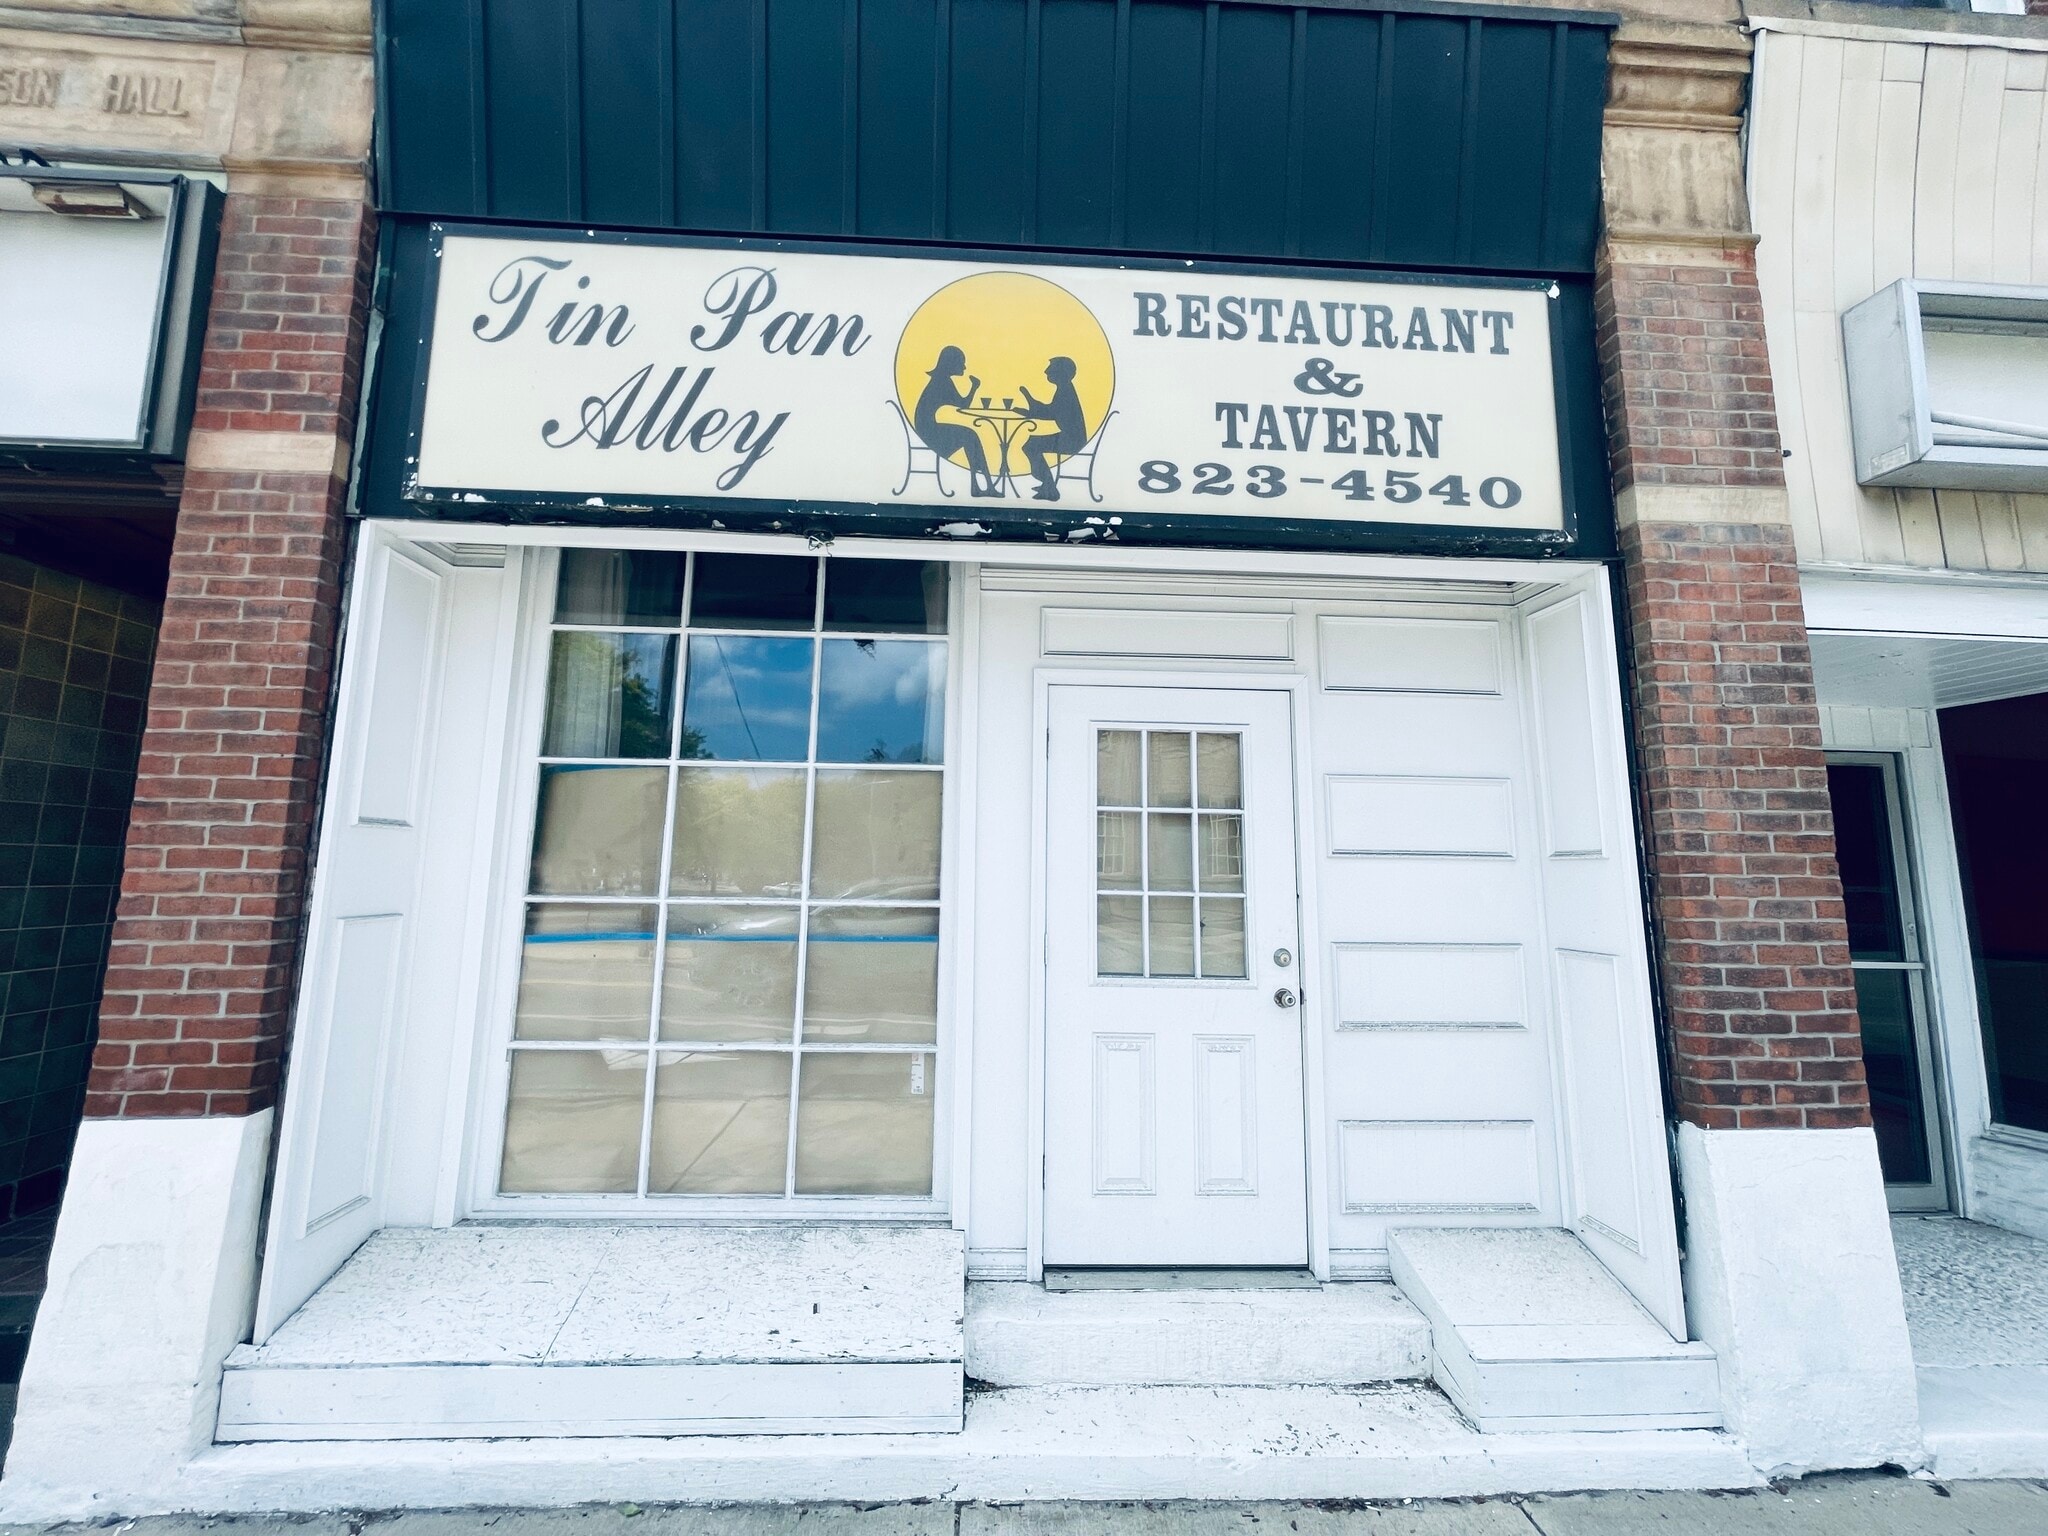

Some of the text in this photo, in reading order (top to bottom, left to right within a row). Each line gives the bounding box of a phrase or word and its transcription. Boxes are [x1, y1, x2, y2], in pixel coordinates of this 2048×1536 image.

[103, 74, 189, 118] HALL
[473, 256, 872, 357] Tin Pan
[1133, 291, 1514, 355] RESTAURANT
[1293, 357, 1364, 398] &
[541, 363, 791, 492] Alley
[1215, 401, 1443, 459] TAVERN
[1137, 460, 1522, 509] 823-4540
